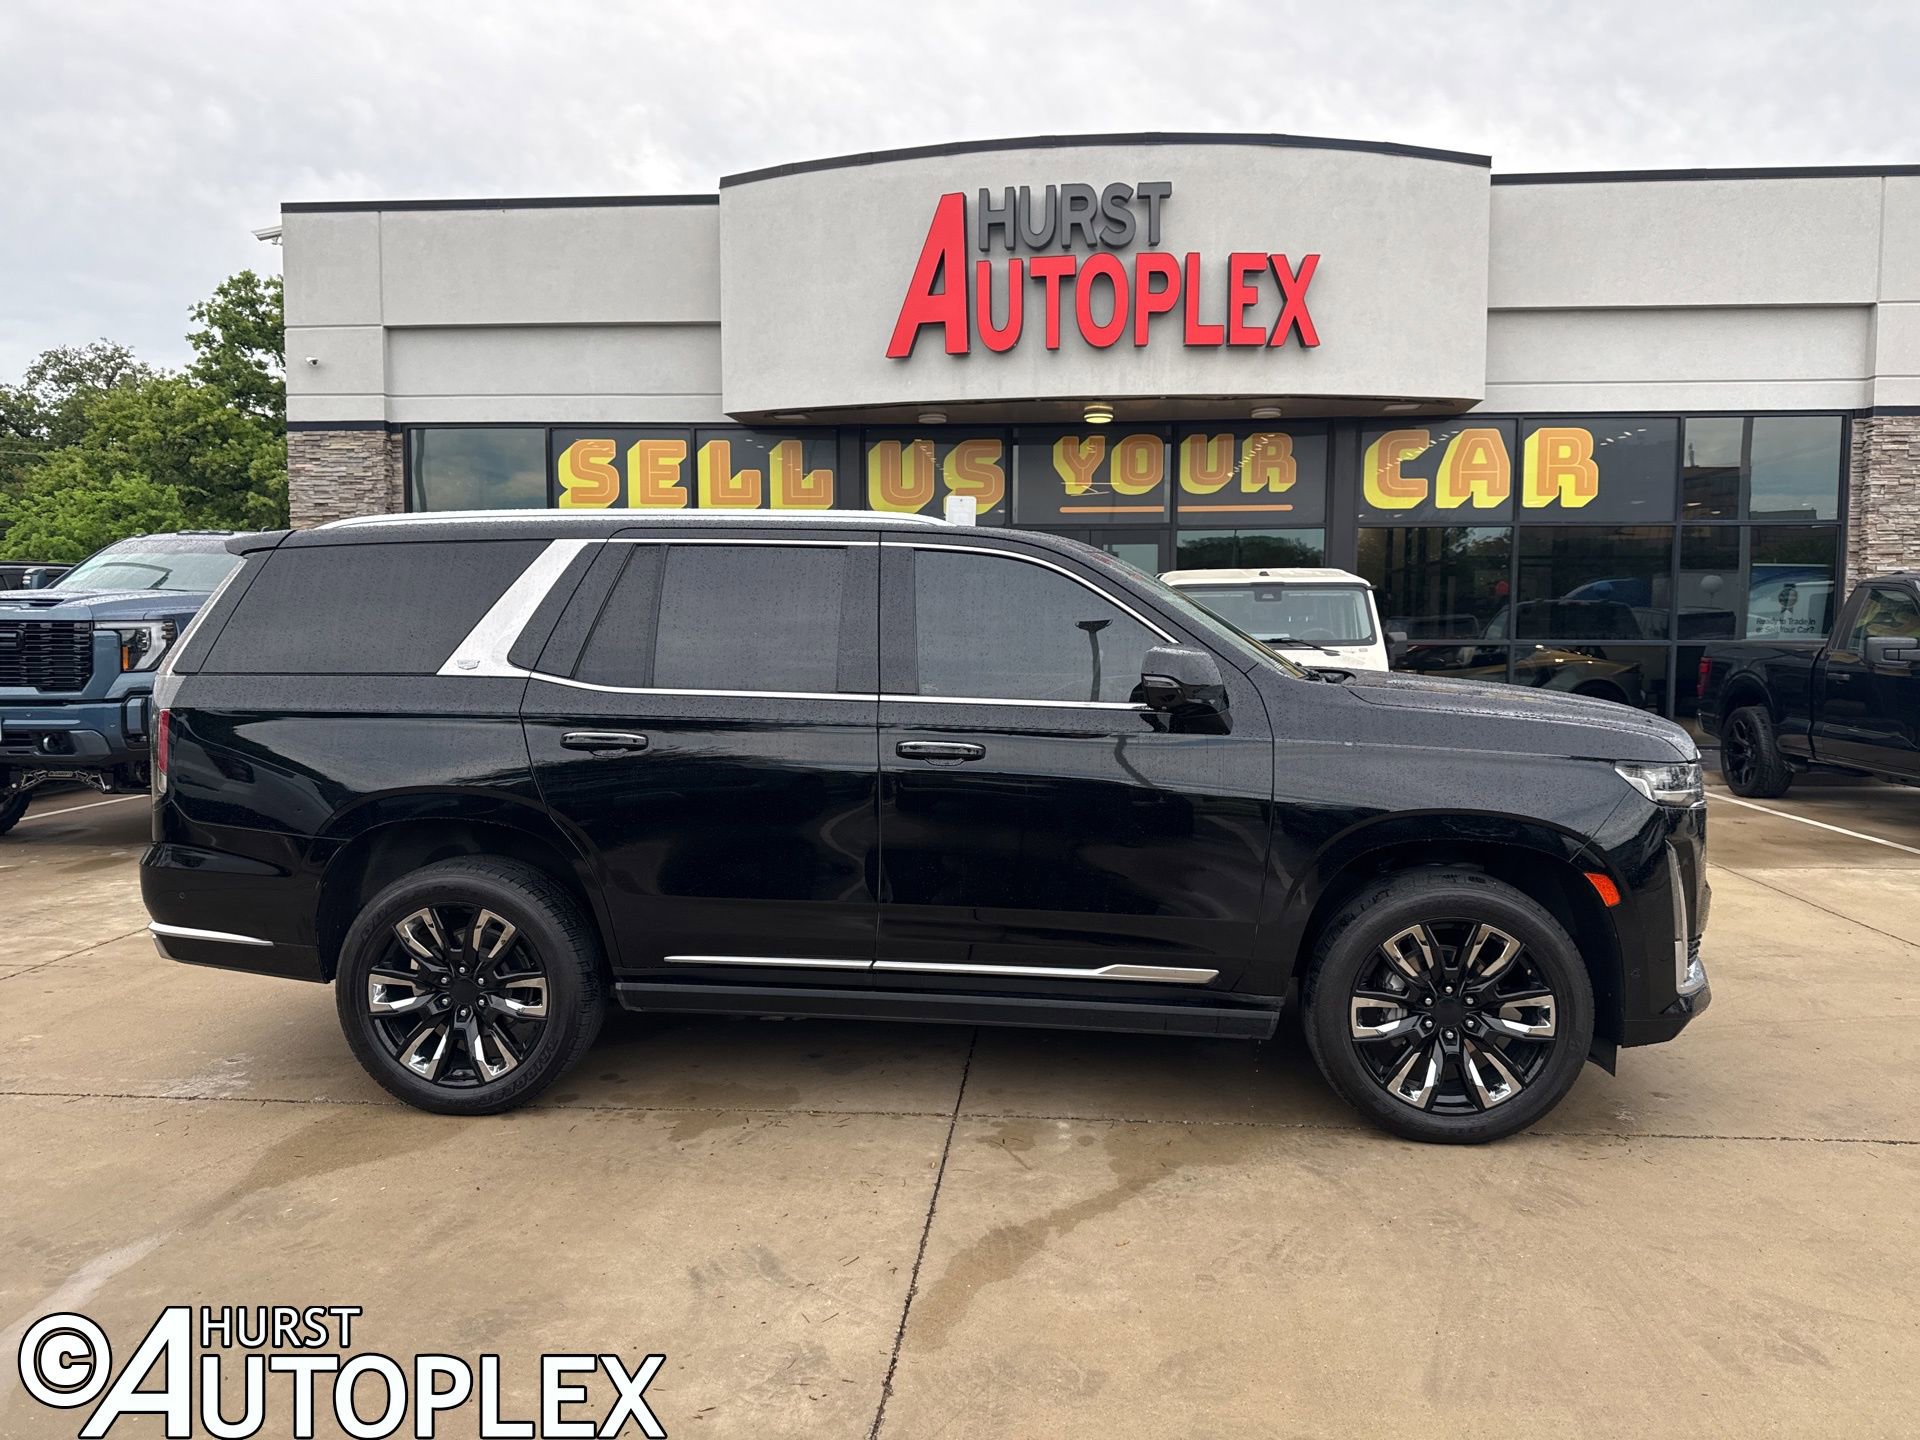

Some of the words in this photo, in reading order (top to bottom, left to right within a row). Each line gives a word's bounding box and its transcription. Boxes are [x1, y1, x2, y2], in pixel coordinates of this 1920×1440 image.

[978, 181, 1172, 252] HURST
[885, 192, 1321, 359] AUTOPLEX
[557, 439, 834, 509] SELL
[867, 438, 1005, 515] US
[1052, 433, 1297, 495] YOUR
[1363, 427, 1599, 509] CAR
